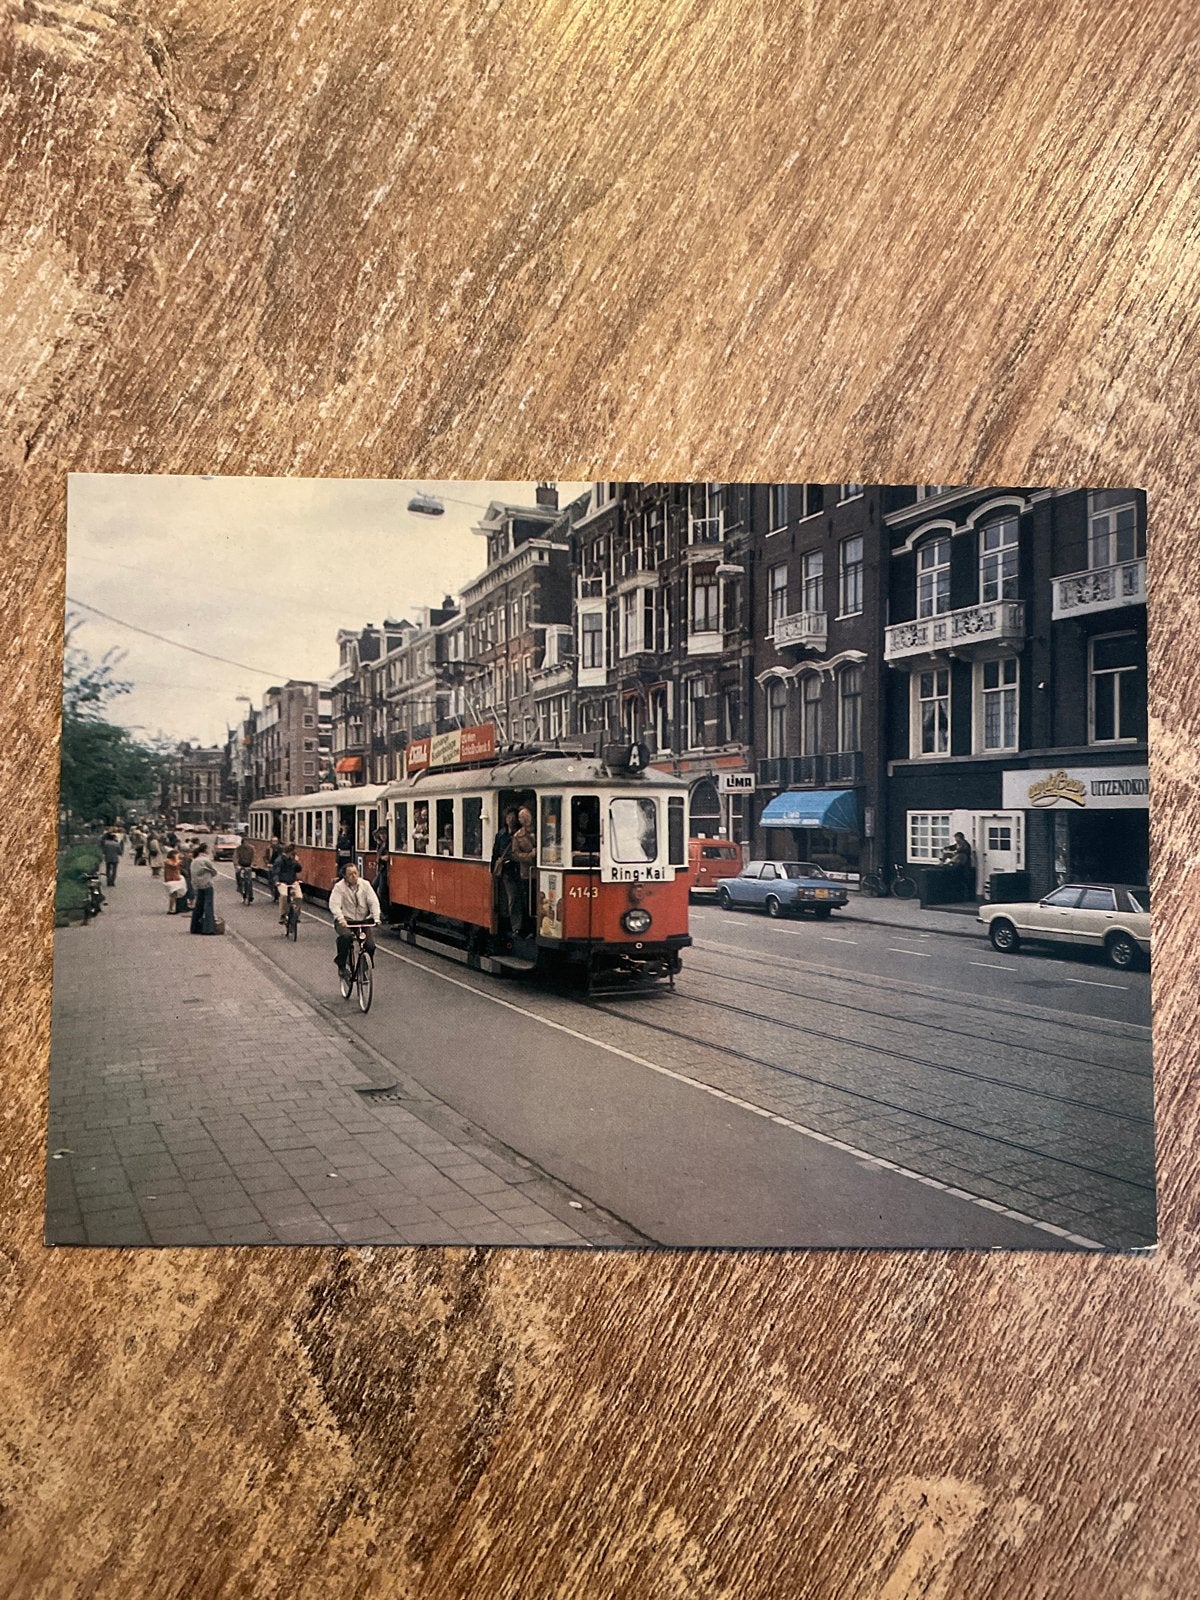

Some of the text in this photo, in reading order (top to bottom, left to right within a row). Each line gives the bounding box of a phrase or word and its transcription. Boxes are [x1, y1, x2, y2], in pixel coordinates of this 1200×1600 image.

[629, 745, 640, 766] A
[611, 867, 665, 882] Ring-Kai
[569, 886, 599, 898] 4143
